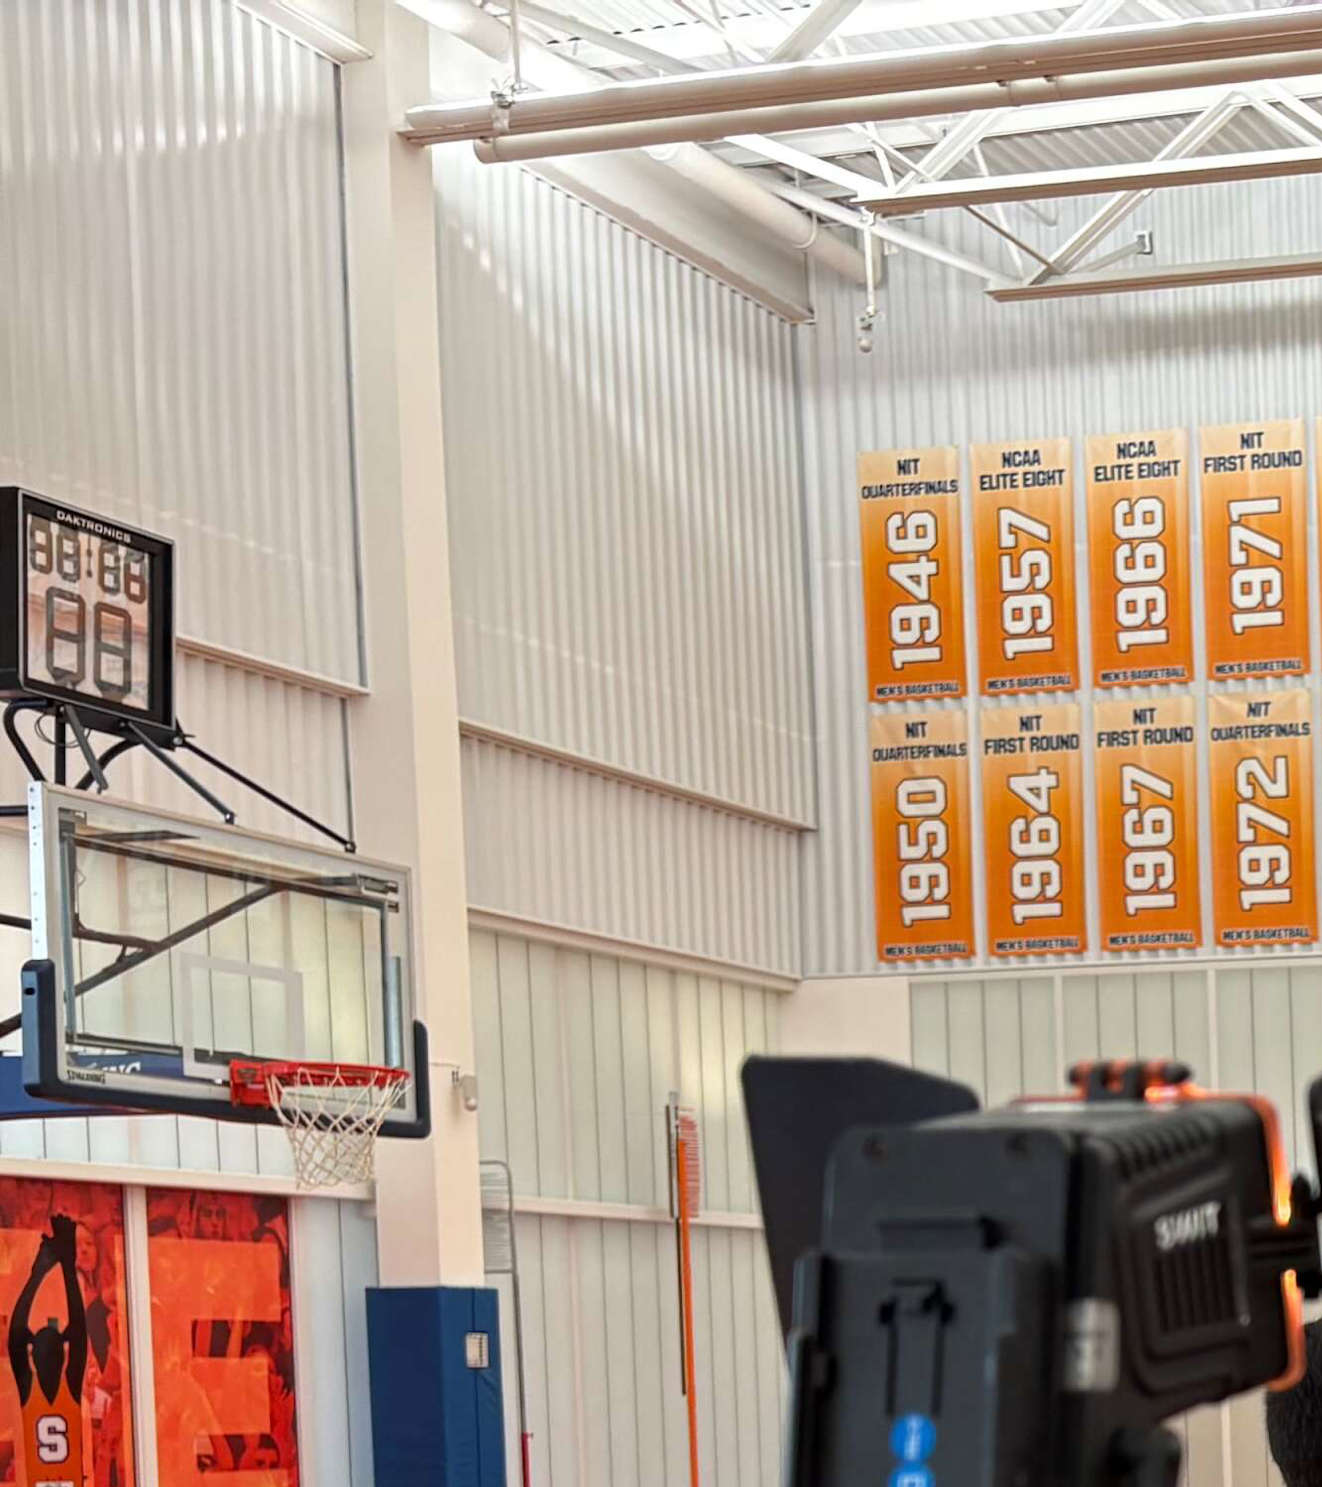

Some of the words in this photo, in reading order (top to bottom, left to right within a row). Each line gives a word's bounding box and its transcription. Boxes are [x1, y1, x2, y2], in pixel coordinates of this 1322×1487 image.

[897, 458, 919, 475] NIT
[1095, 463, 1134, 482] ELITE
[1137, 459, 1180, 479] EIGHT
[1117, 441, 1156, 459] NCAA
[862, 479, 958, 499] QUARTERFINALS
[56, 509, 132, 544] DAKTRONICS
[999, 507, 1053, 659] 1957
[1112, 497, 1168, 652] 1966
[1228, 497, 1284, 635] 1971
[885, 511, 941, 669] 1946
[906, 722, 927, 739] NIT
[1097, 729, 1140, 747] FIRST
[1143, 726, 1193, 744] ROUND
[1133, 708, 1155, 725] NIT
[873, 743, 967, 762] QUARTERFINALS
[897, 776, 951, 927] 1950
[1009, 768, 1062, 925] 1964
[1122, 764, 1176, 915] 1967
[1236, 756, 1291, 911] 1972
[36, 1414, 70, 1464] S
